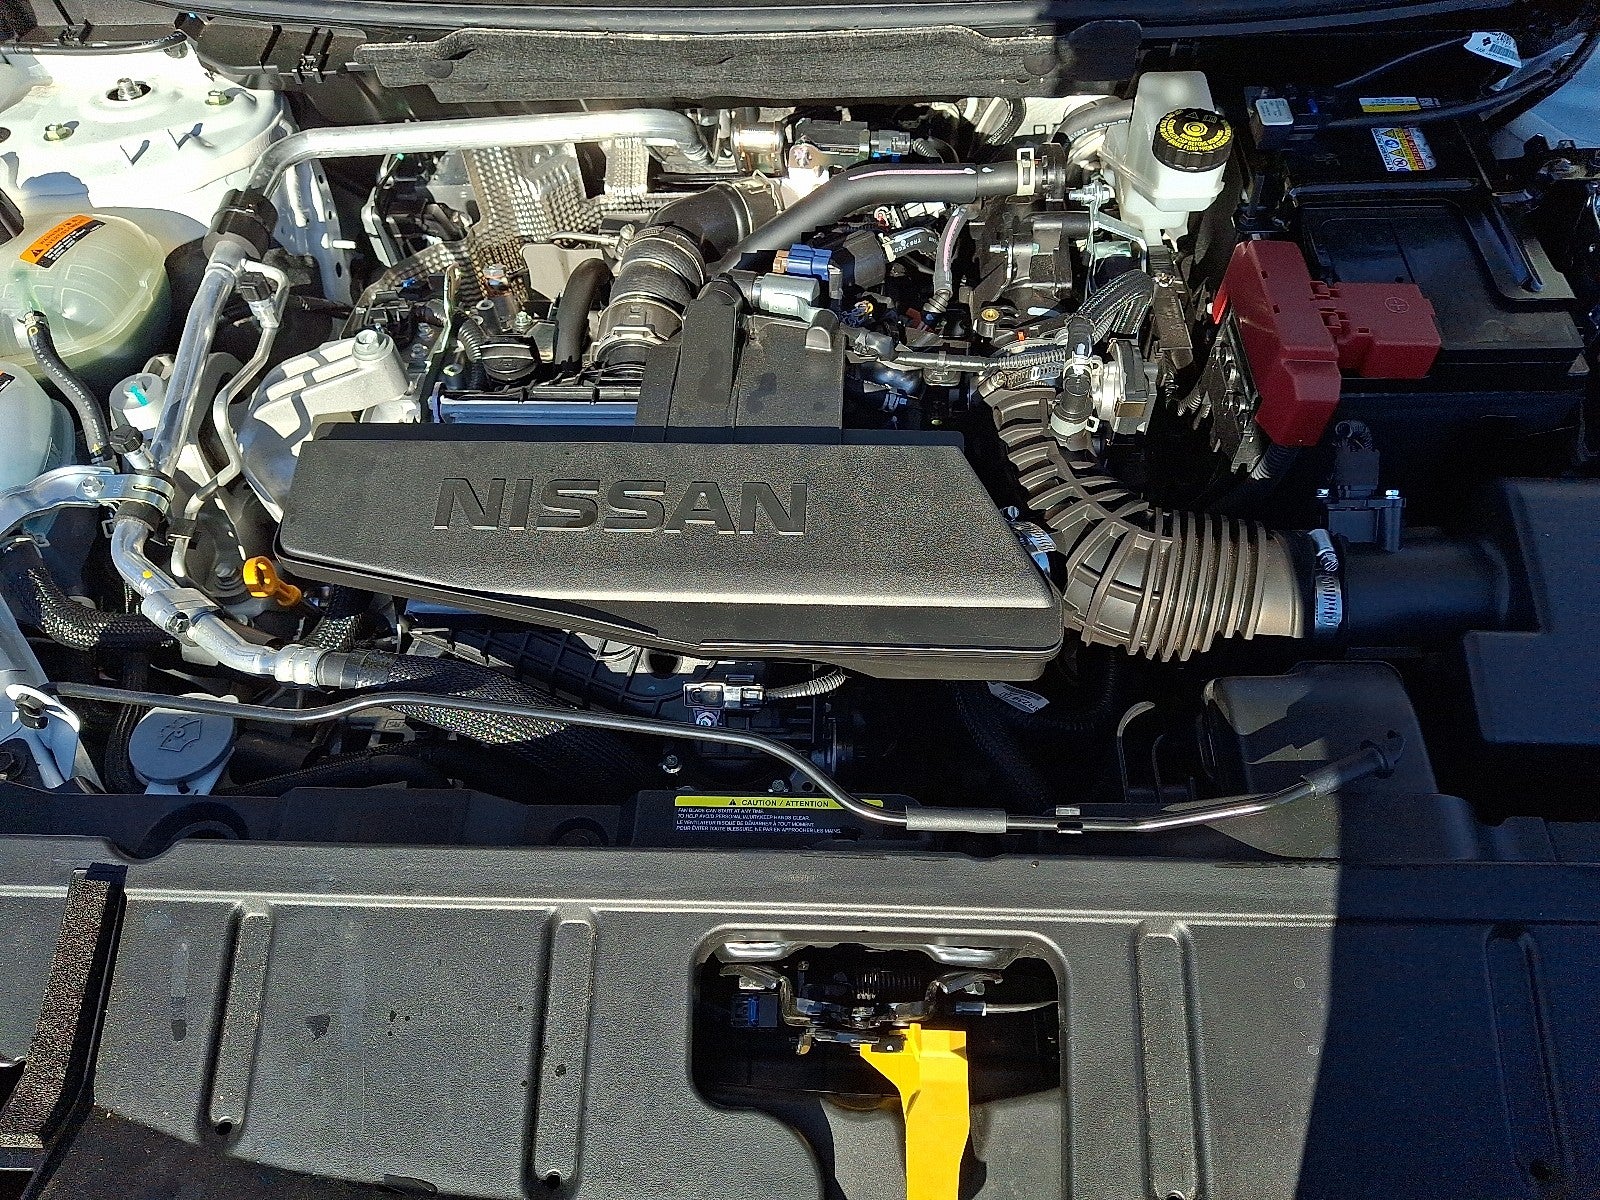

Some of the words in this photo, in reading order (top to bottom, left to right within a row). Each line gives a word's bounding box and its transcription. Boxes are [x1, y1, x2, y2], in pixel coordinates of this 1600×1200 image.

[433, 478, 808, 535] NISSAN
[741, 799, 777, 807] CAUTION
[785, 800, 829, 808] ATTENTION
